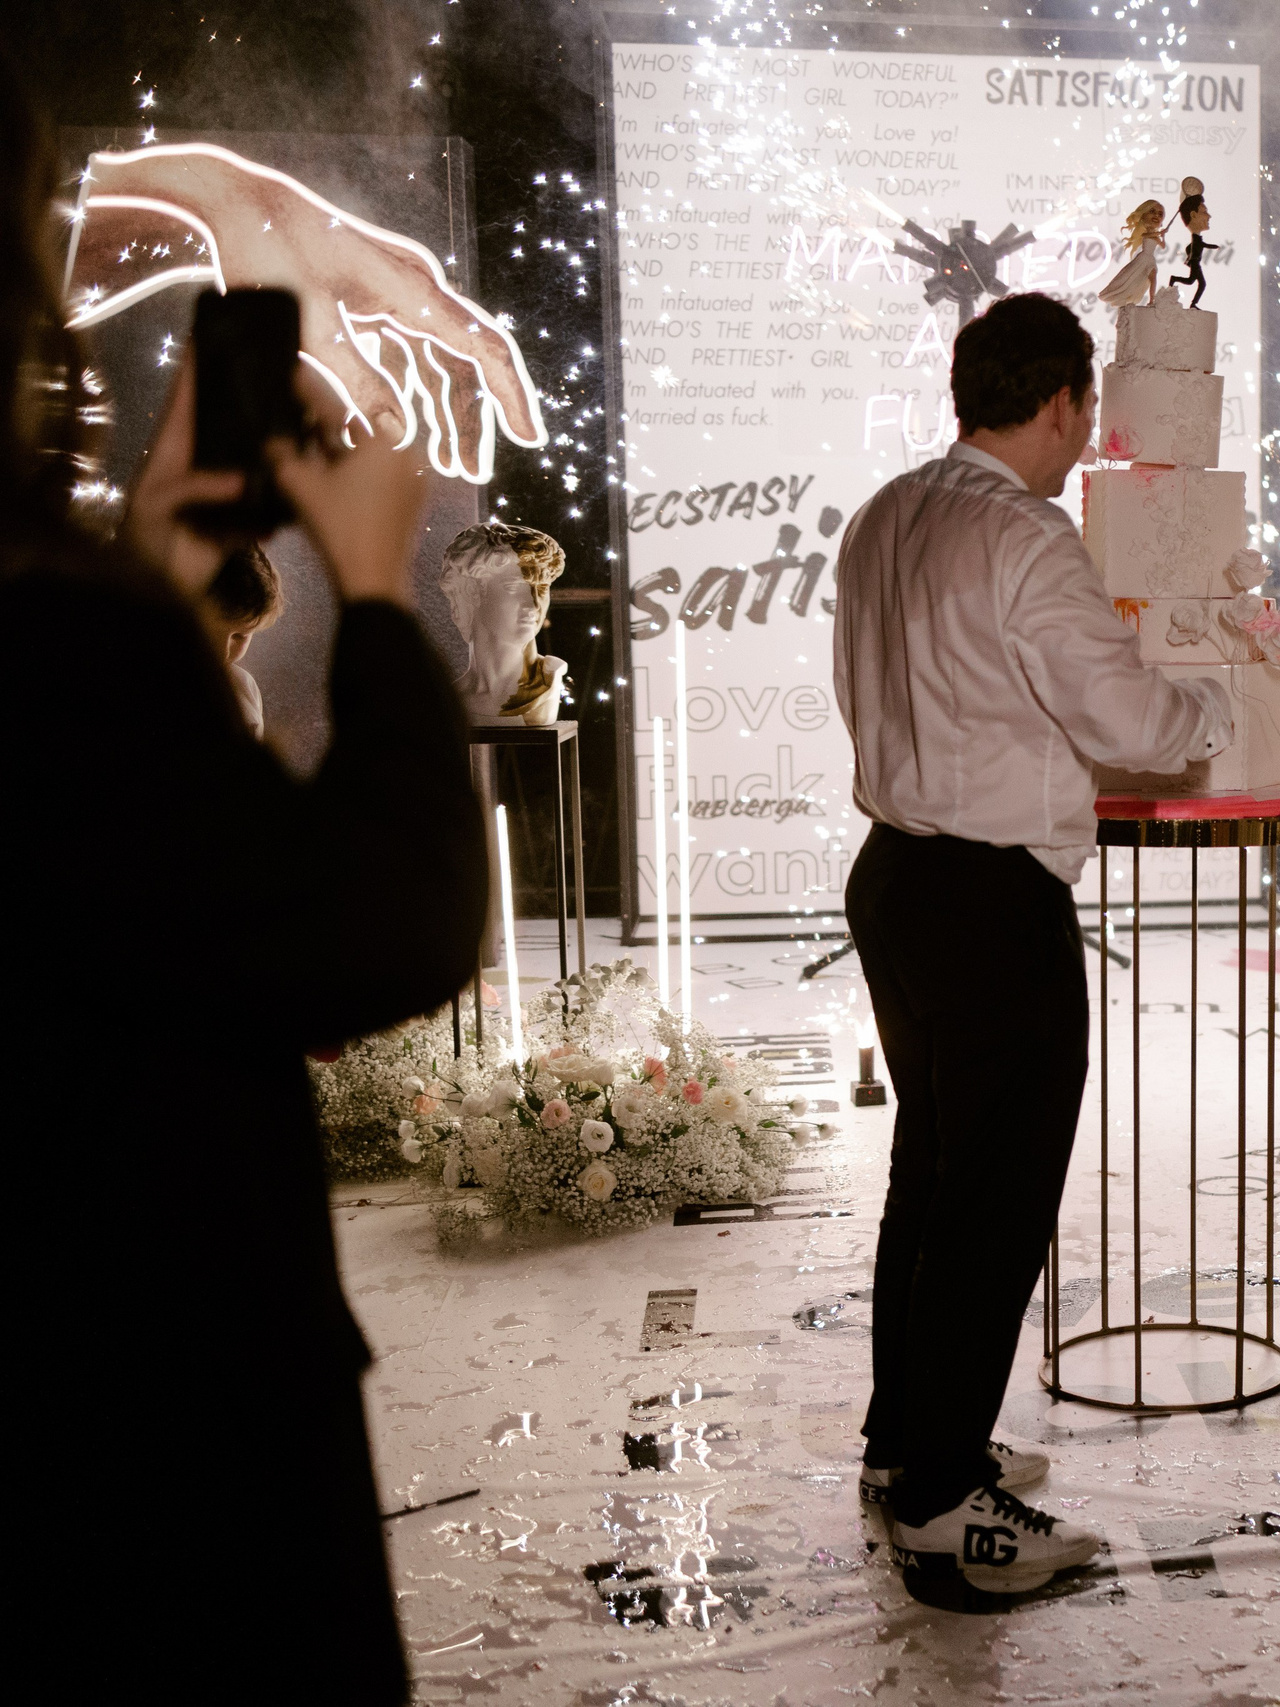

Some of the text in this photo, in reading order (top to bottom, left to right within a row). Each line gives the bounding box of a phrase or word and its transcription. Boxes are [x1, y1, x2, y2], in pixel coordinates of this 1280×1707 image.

[752, 58, 811, 78] MOST
[832, 60, 957, 82] WONDERFUL
[614, 81, 658, 100] AND
[804, 87, 847, 107] GIRL
[873, 89, 960, 110] TODAY?"
[985, 67, 1245, 112] SATISFACTION
[763, 118, 801, 138] wih
[873, 123, 916, 142] Love
[930, 125, 960, 146] ya!
[834, 149, 960, 170] WONDERFUL
[616, 170, 661, 190] AND
[875, 177, 961, 197] TODAY?"
[1005, 172, 1182, 194] I'M INFATATED
[659, 203, 752, 225] nfatuated
[714, 233, 751, 252] THE
[619, 259, 663, 278] AND
[689, 261, 785, 280] PRETTIEST
[660, 291, 753, 312] infatuated
[878, 297, 920, 315] Love
[717, 321, 753, 340] THE
[767, 322, 824, 340] MOST
[622, 347, 666, 365] AND
[811, 350, 853, 367] GIRL
[880, 350, 948, 369] TODAY
[771, 380, 806, 399] with
[821, 386, 859, 404] you.
[625, 406, 774, 427] Married as fuck.
[628, 475, 815, 533] ECSTASY
[632, 666, 830, 732] Love
[635, 745, 827, 820] Fuck
[637, 835, 849, 897] want
